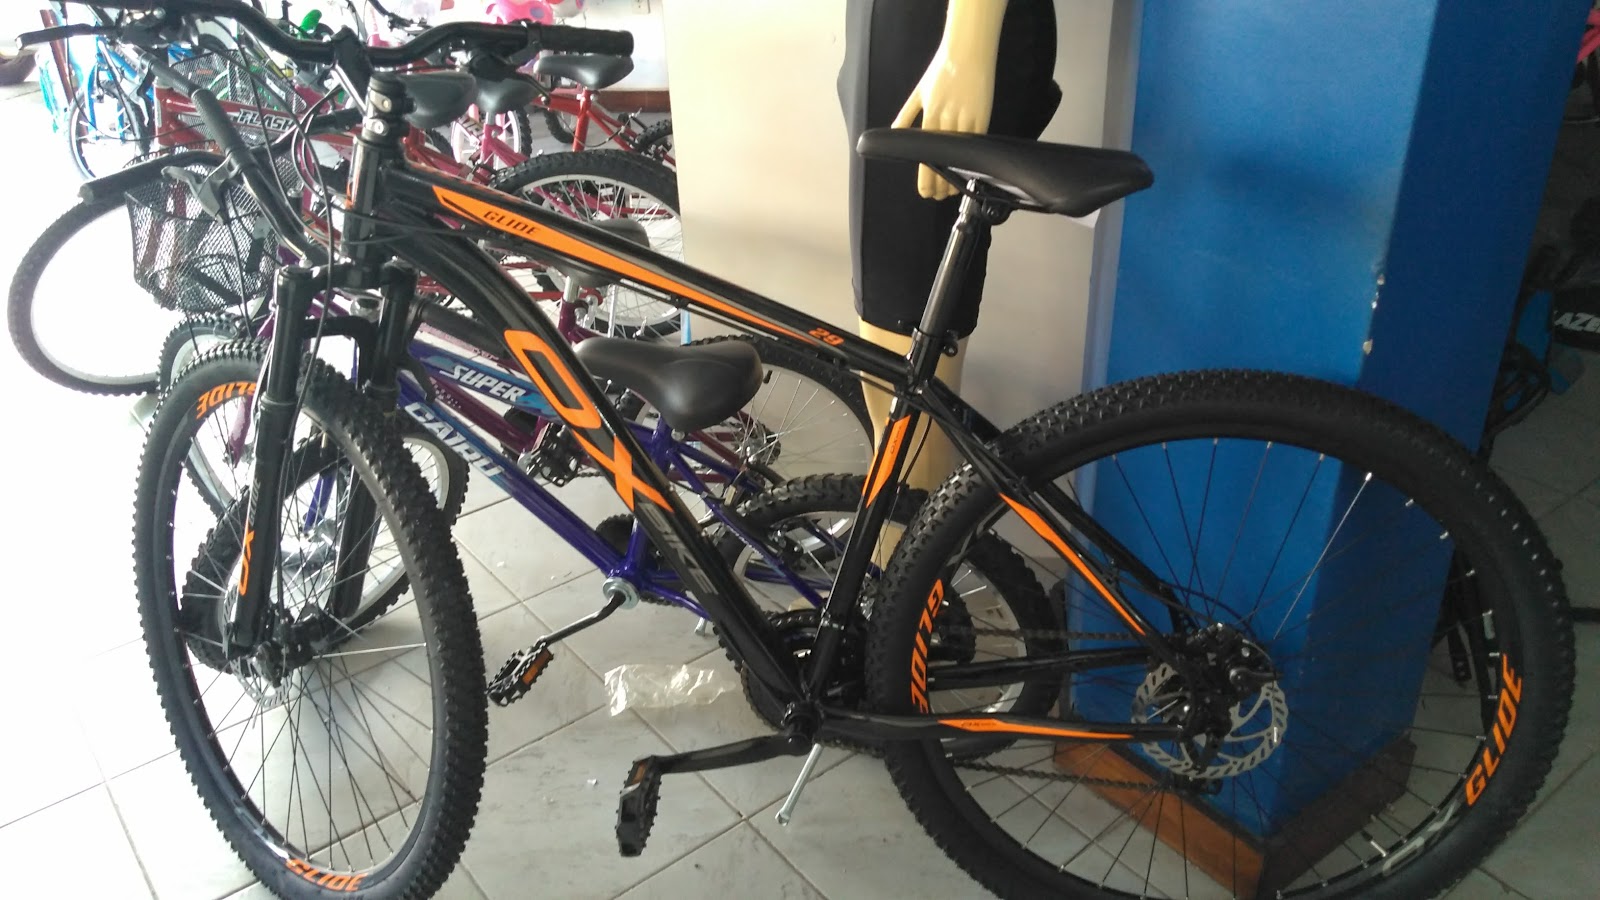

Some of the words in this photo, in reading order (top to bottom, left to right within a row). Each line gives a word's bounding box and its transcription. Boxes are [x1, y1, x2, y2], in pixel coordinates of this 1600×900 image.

[483, 211, 540, 235] GLIDE
[808, 327, 845, 347] 29
[439, 364, 527, 403] SUPER
[404, 401, 504, 478] CAIRU
[503, 329, 675, 513] OX
[641, 502, 719, 595] BIKE
[911, 578, 945, 714] GLIDE
[1465, 653, 1523, 806] GLIDE
[286, 857, 369, 892] GLIDE
